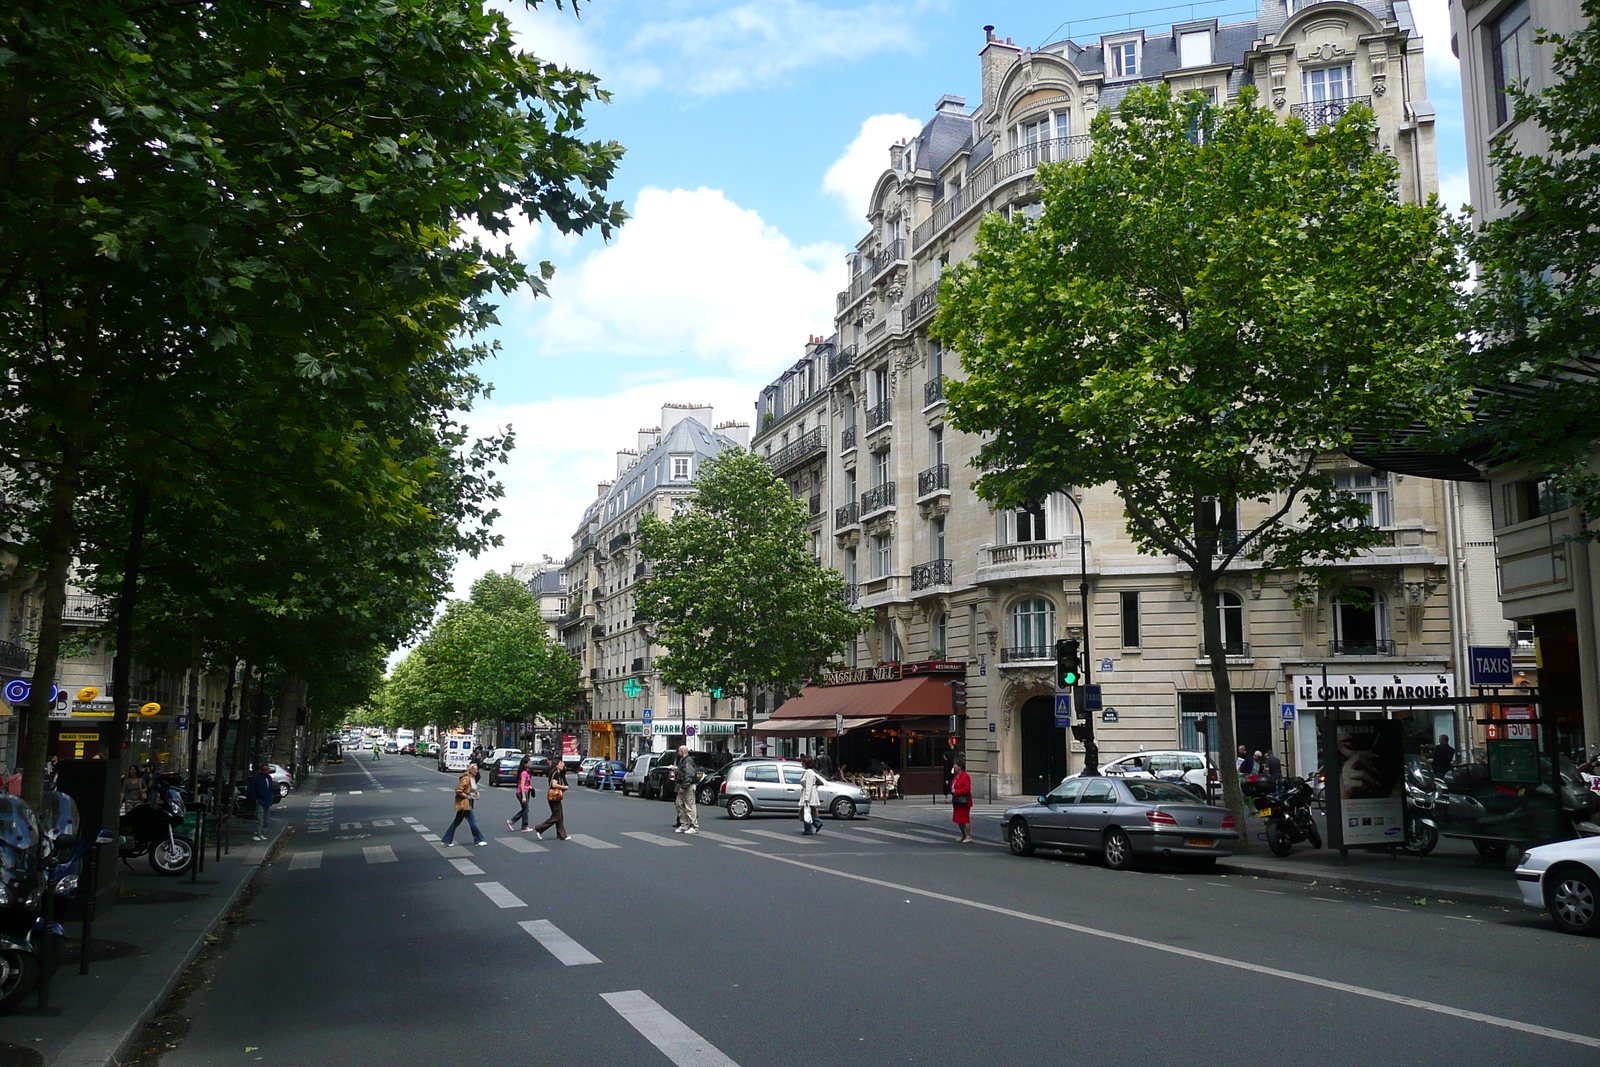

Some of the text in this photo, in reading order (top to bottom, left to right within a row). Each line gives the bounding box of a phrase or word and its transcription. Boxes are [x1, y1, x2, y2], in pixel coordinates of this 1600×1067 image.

[1476, 657, 1510, 674] TAXIS
[872, 666, 895, 680] NIEL
[1300, 685, 1449, 699] LE COIN DES MARQUES
[654, 725, 699, 733] PHARME
[704, 725, 734, 733] LA PHARMACI
[1336, 725, 1375, 734] SAMSUNG
